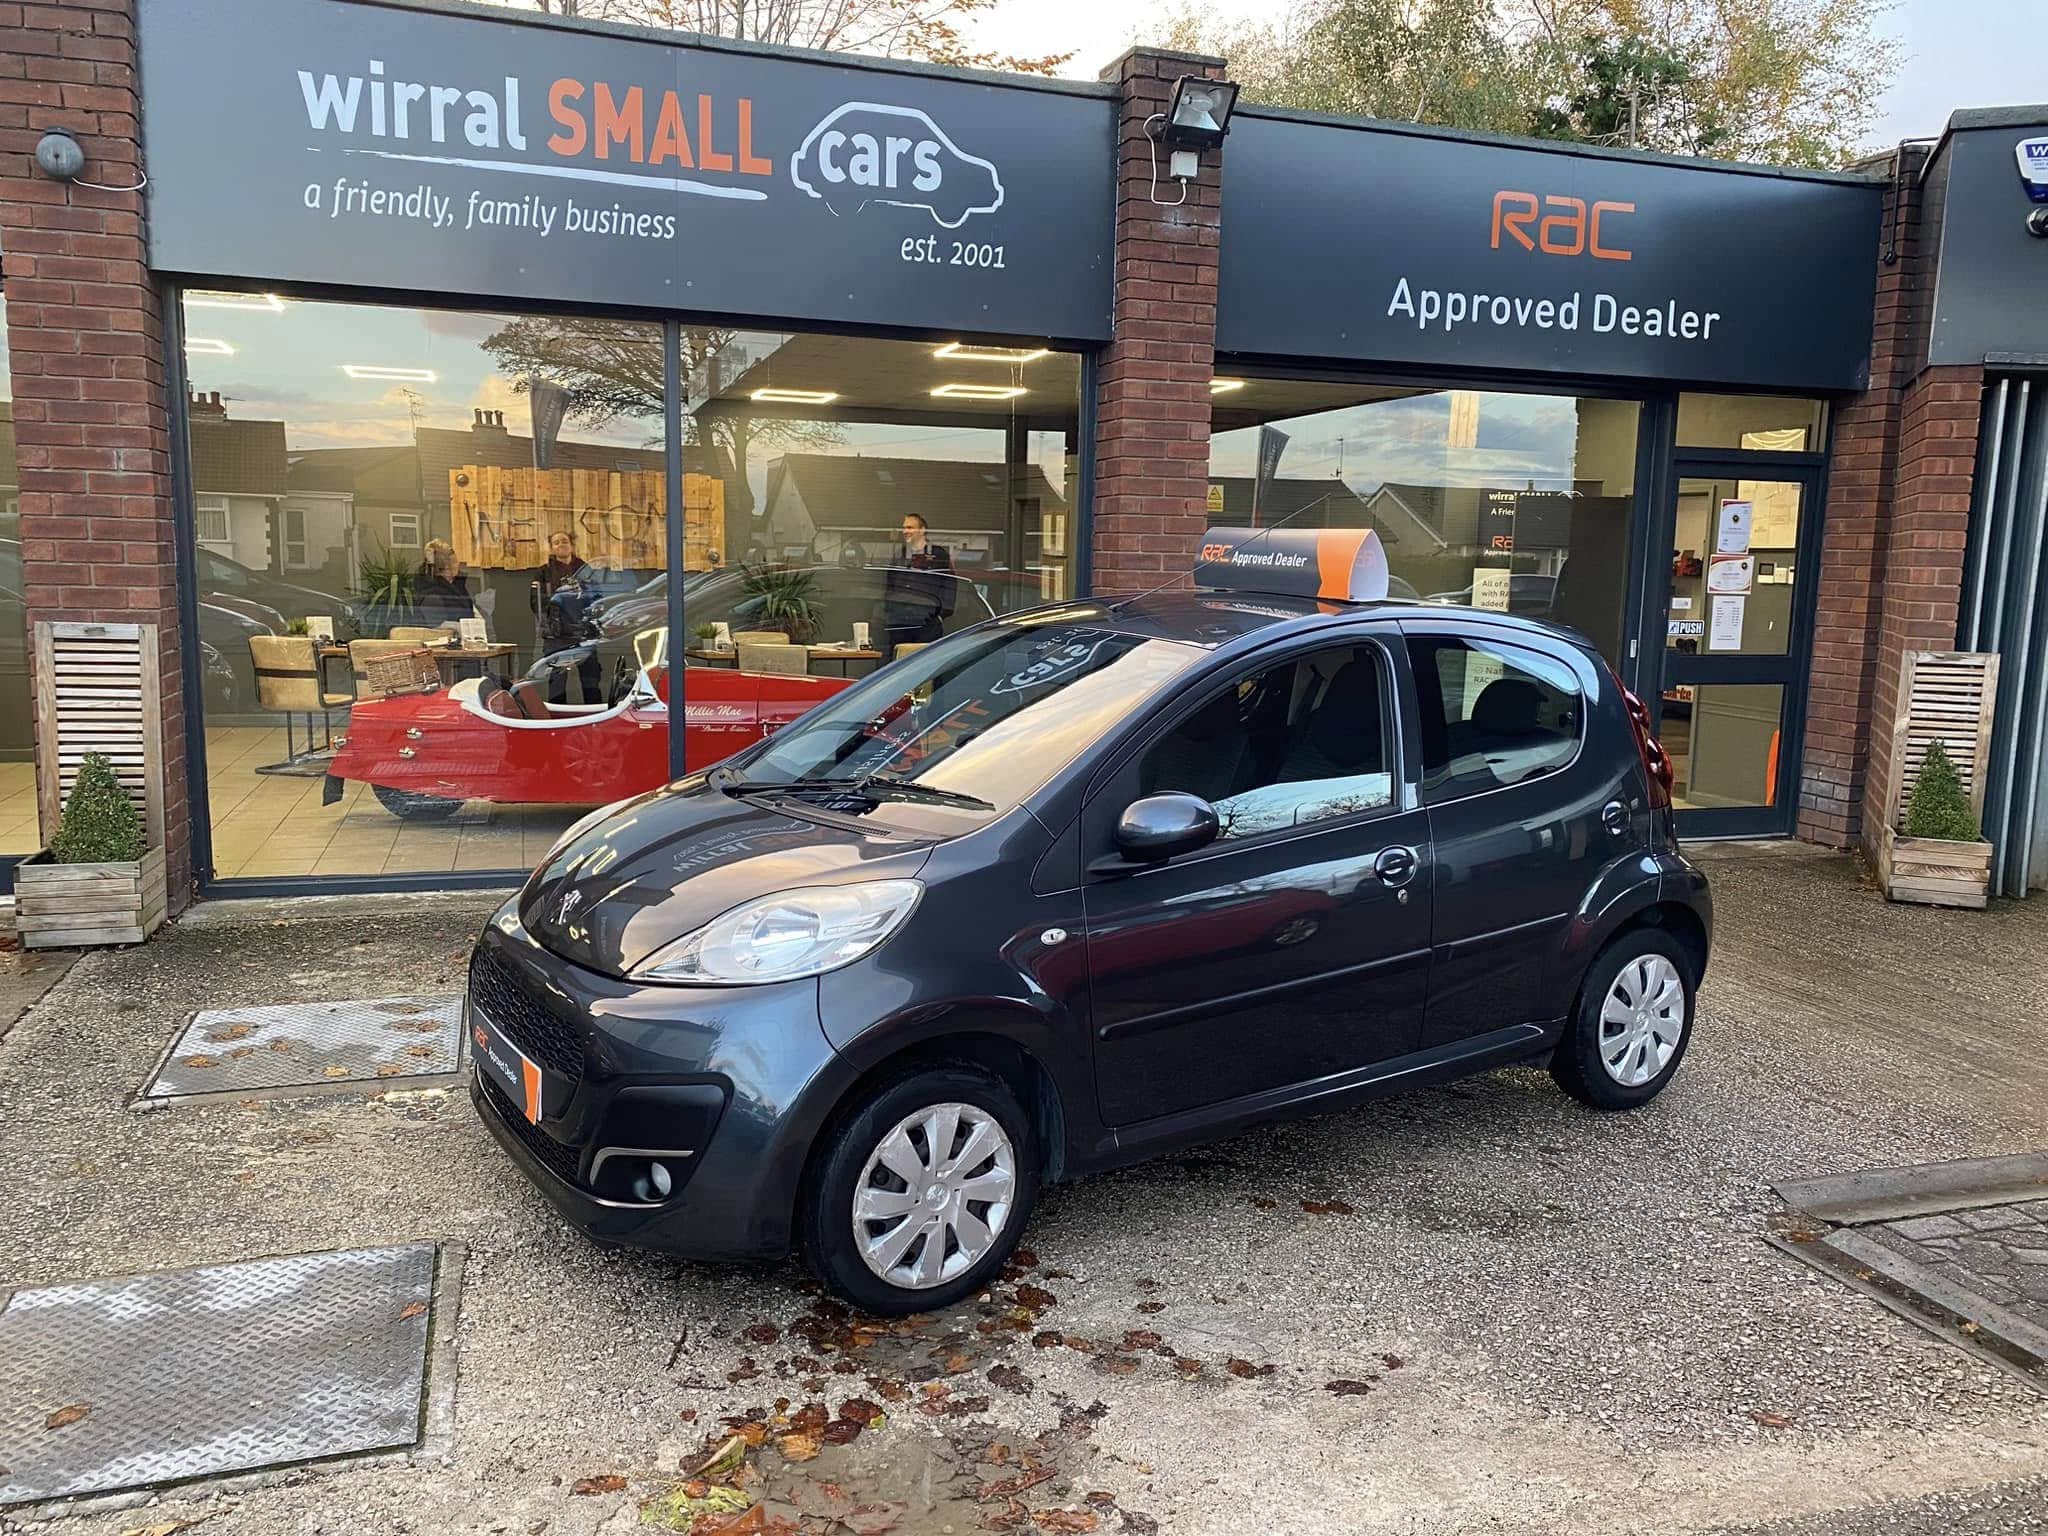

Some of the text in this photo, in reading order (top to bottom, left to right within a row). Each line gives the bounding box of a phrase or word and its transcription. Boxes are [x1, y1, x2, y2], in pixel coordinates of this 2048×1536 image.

[297, 59, 943, 192] wirral SMALL cars
[303, 178, 677, 240] a friendly, family business
[1490, 190, 1635, 261] RAC
[900, 234, 1006, 269] est. 2001
[1387, 277, 1721, 340] Approved Dealer
[1232, 551, 1273, 567] Approved
[1275, 553, 1308, 567] Dealer
[1680, 622, 1702, 634] PUSH
